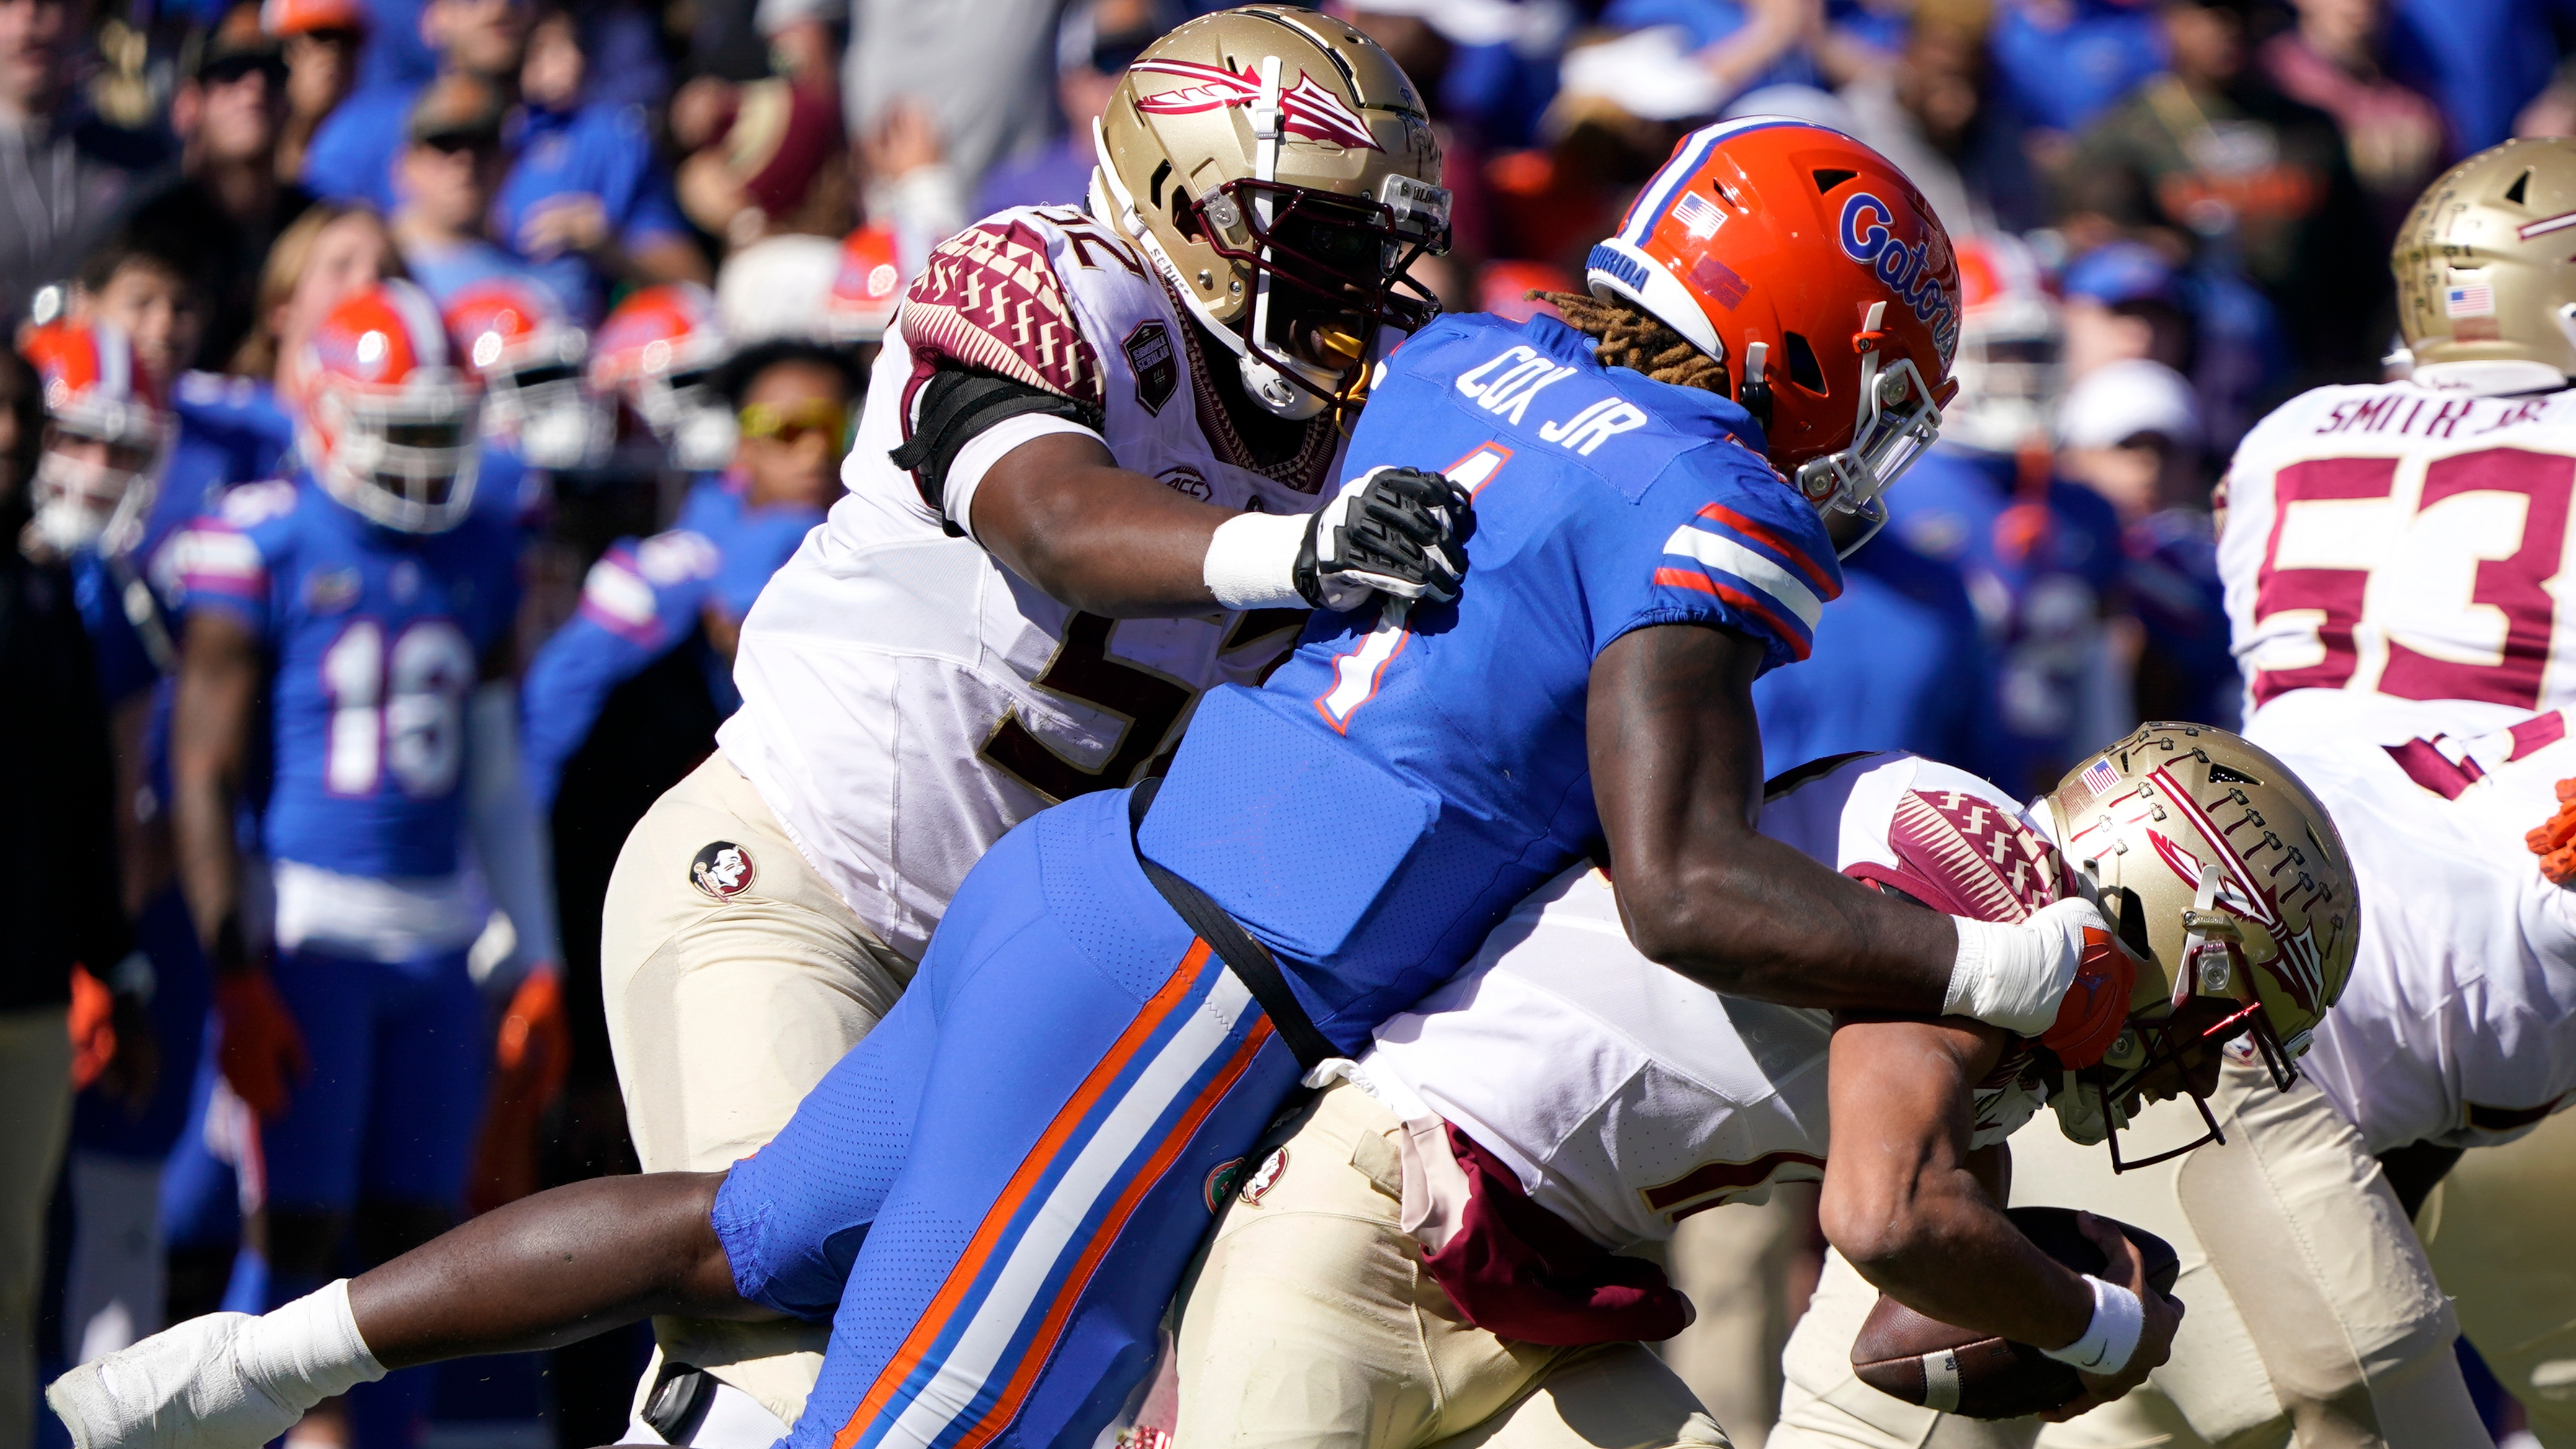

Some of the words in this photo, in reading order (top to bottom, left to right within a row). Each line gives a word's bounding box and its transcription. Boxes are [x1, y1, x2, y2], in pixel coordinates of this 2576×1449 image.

[1585, 244, 1650, 295] LORIDA
[1840, 192, 1958, 358] Gators
[1136, 345, 1170, 373] SCHOLAR
[1456, 345, 1578, 426] COX
[1538, 396, 1648, 457] JR
[2315, 395, 2475, 439] SMITH
[1165, 476, 1207, 497] ACC
[2250, 443, 2576, 713] 53
